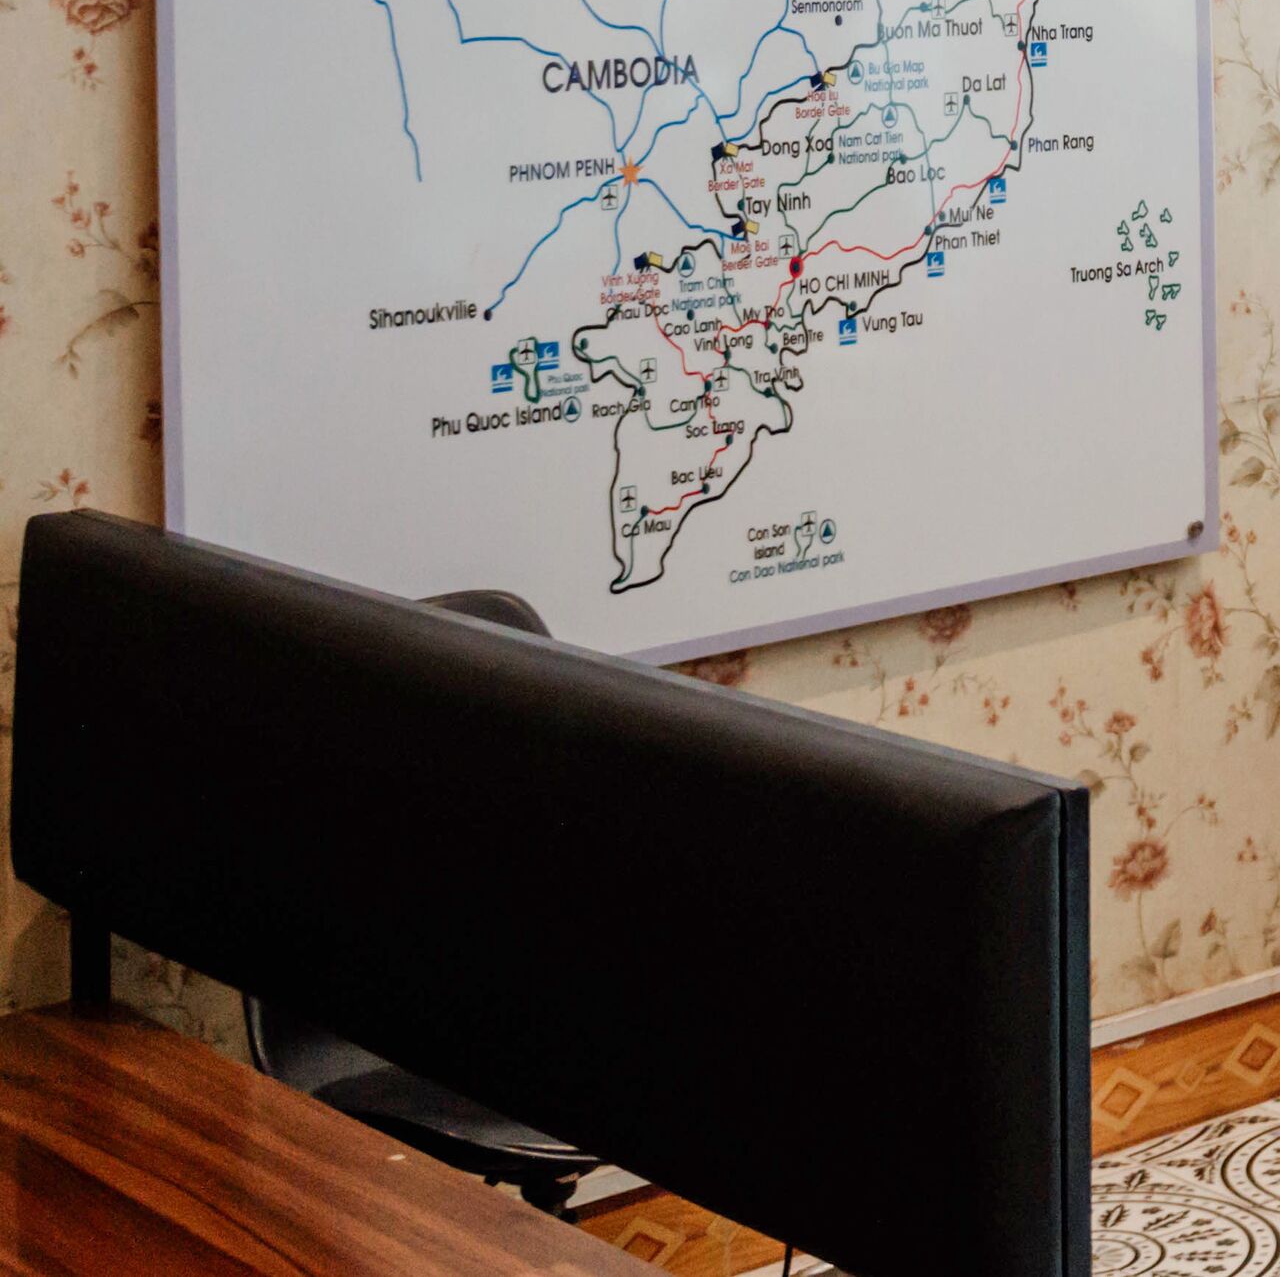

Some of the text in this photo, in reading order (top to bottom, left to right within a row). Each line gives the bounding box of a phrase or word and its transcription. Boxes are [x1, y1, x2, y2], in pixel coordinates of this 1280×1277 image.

[917, 19, 941, 38] Ma
[945, 17, 983, 37] Thuot
[1031, 24, 1094, 42] Nha Trang
[541, 54, 701, 94] CAMBODIA
[962, 73, 1007, 93] Da Lat
[761, 135, 835, 158] Dong Xoa
[1028, 134, 1095, 154] Phan Rang
[508, 157, 616, 184] PHNOM PENH
[887, 164, 946, 184] Bao Loc
[746, 192, 812, 219] Tay Ninh
[949, 204, 995, 224] Mui Ne
[935, 228, 1001, 251] Phan Thiet
[1070, 257, 1164, 284] Truong Sa Arch
[799, 269, 891, 296] HO CHI MINH
[664, 323, 691, 338] Cao
[862, 311, 924, 333] Vung Tau
[783, 329, 824, 345] Ben Tre
[431, 400, 563, 438] Phu Quoc Island
[685, 423, 709, 440] Soc
[671, 468, 695, 485] Bac
[621, 517, 672, 539] Ca Mau
